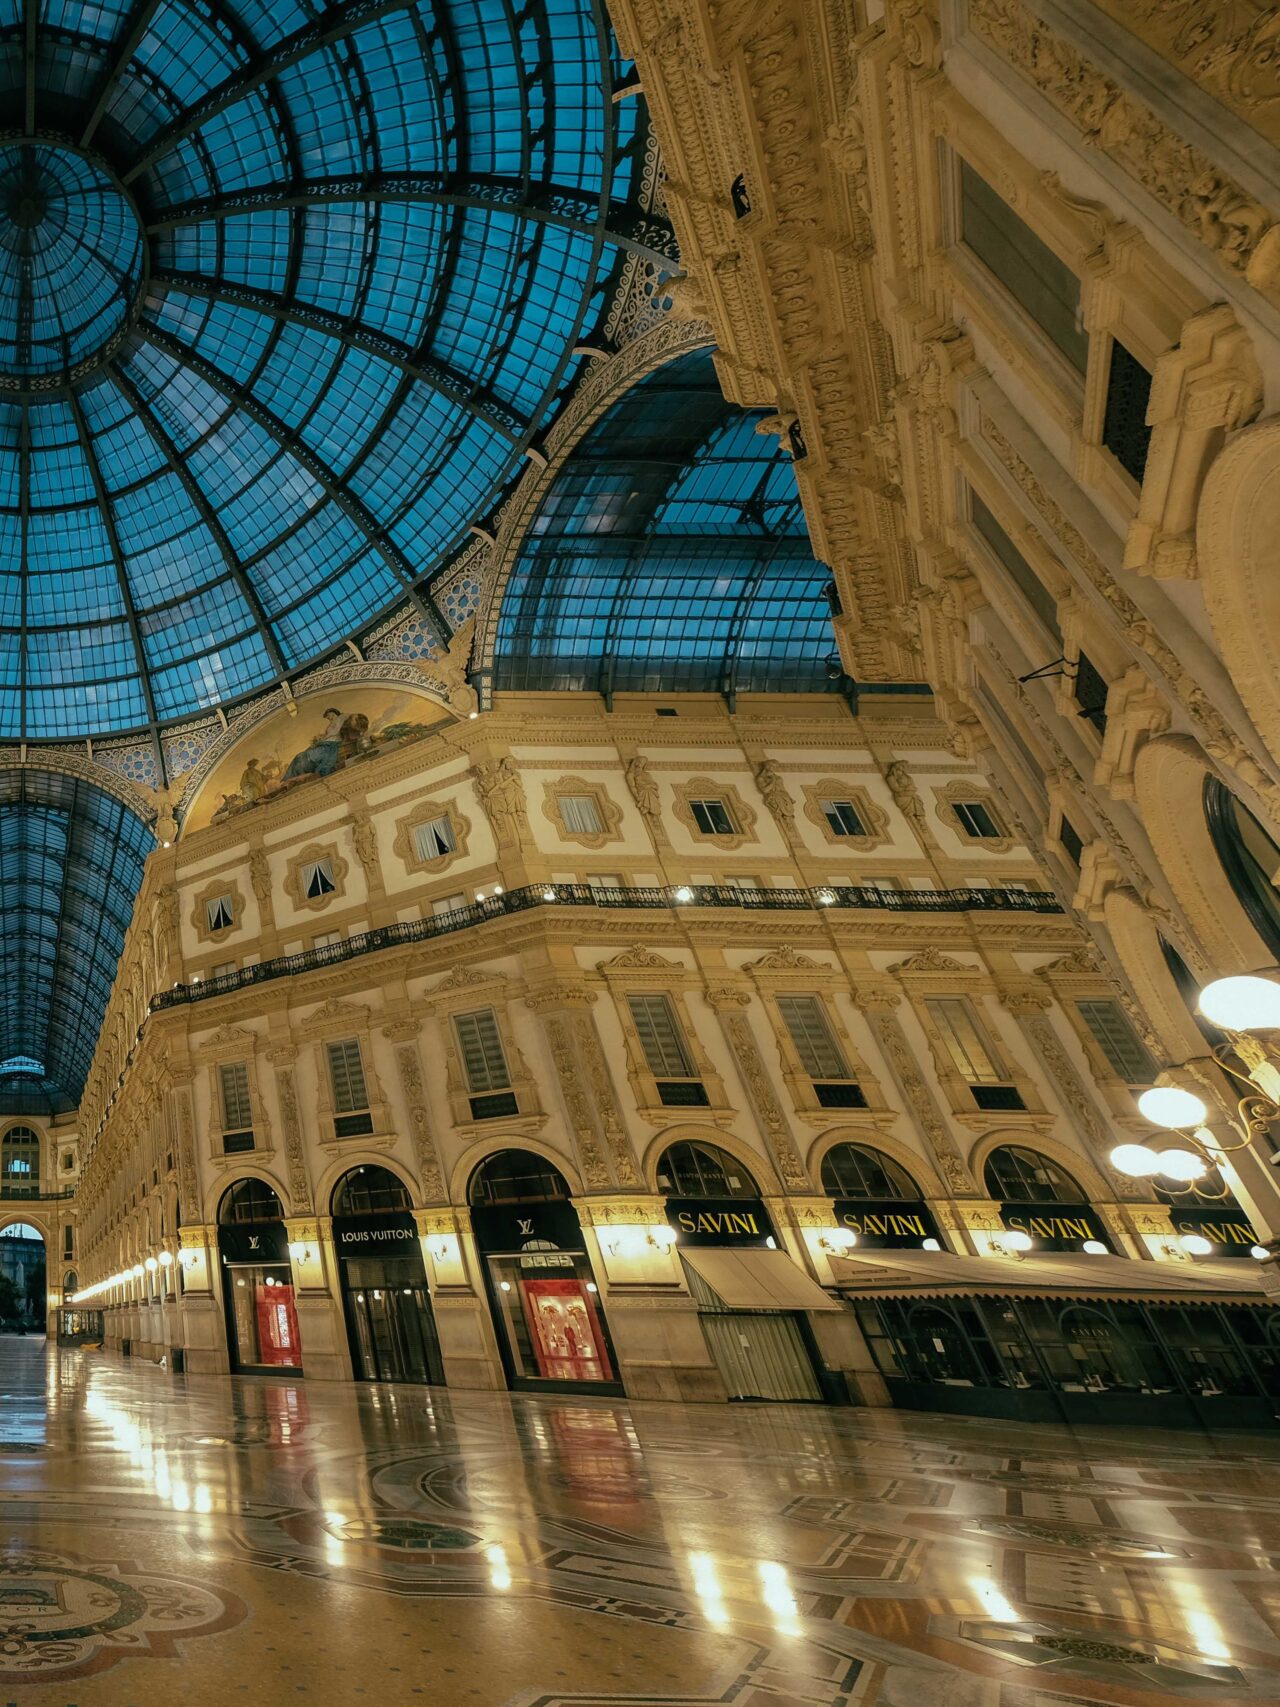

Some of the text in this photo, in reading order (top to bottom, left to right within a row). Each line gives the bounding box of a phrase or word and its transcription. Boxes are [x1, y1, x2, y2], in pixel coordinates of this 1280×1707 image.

[678, 1212, 760, 1234] SAVINI
[843, 1213, 927, 1236] SAVINI
[1008, 1216, 1096, 1240] SAVINI
[1179, 1222, 1260, 1245] SAVIN
[341, 1229, 414, 1243] LOUIS VUITTON
